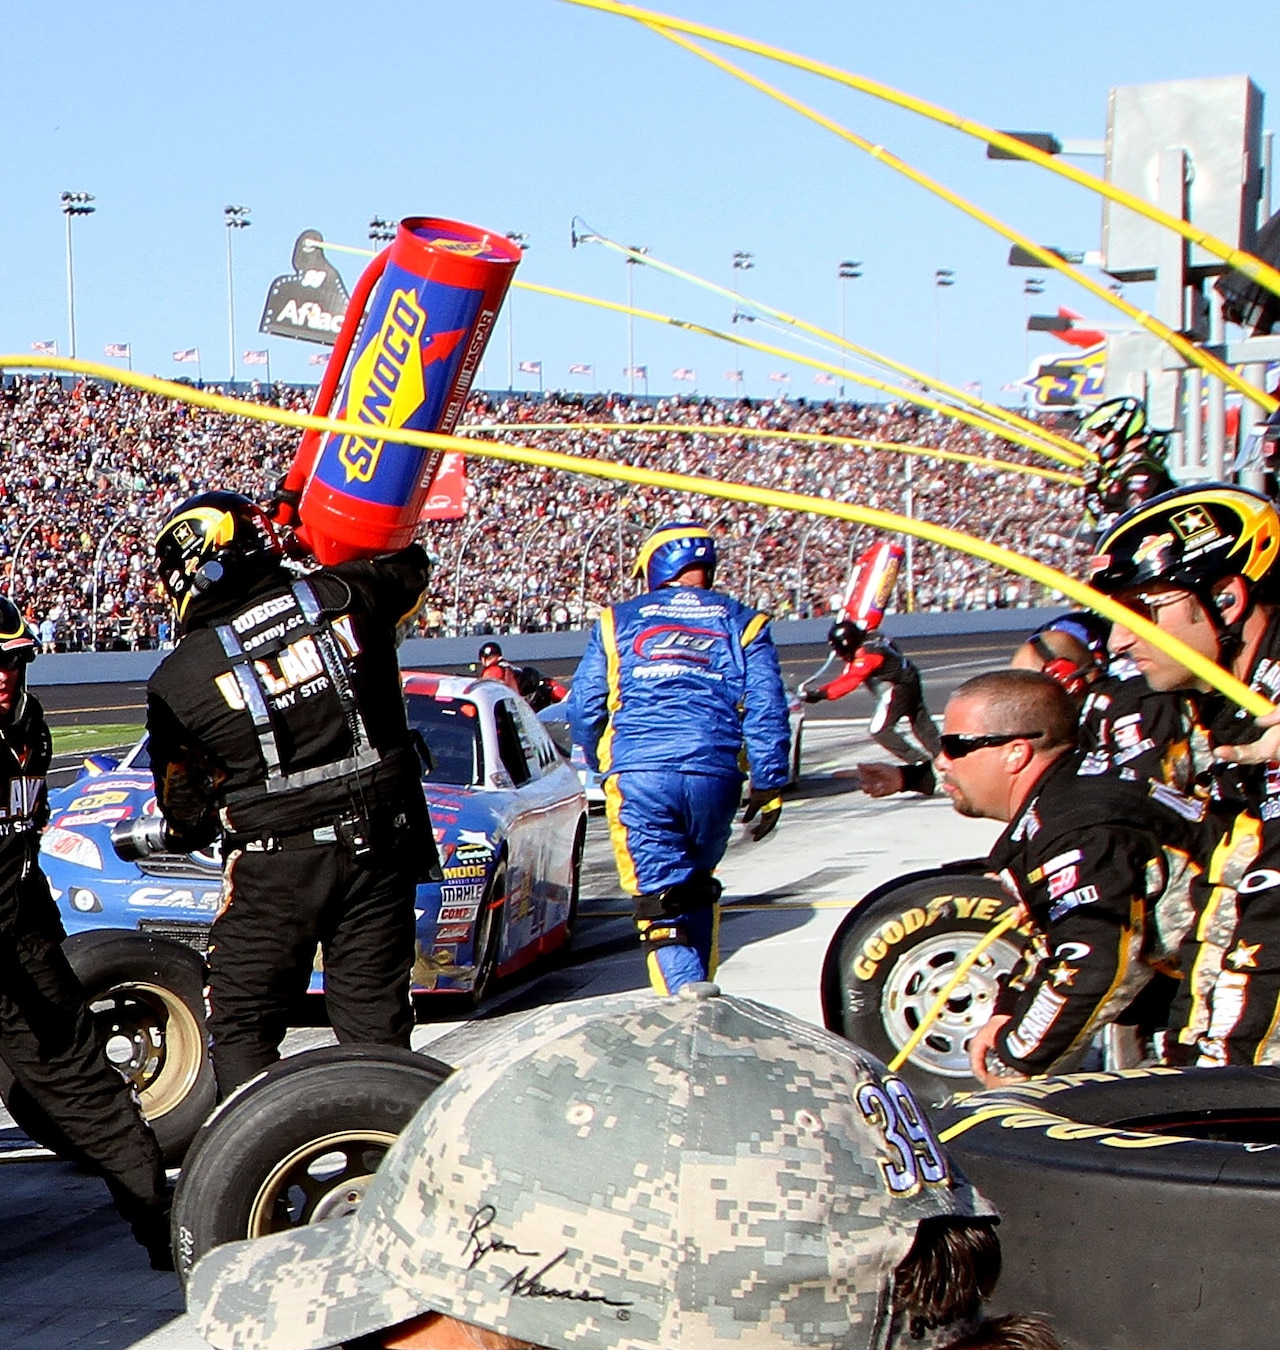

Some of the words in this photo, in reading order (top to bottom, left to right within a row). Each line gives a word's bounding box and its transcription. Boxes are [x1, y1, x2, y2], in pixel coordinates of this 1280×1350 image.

[276, 300, 345, 332] Aflac
[441, 399, 460, 432] FUEL
[464, 310, 494, 373] NASCAR
[243, 614, 305, 650] oarmy.co
[442, 865, 486, 879] MOOG
[852, 1074, 953, 1199] 39
